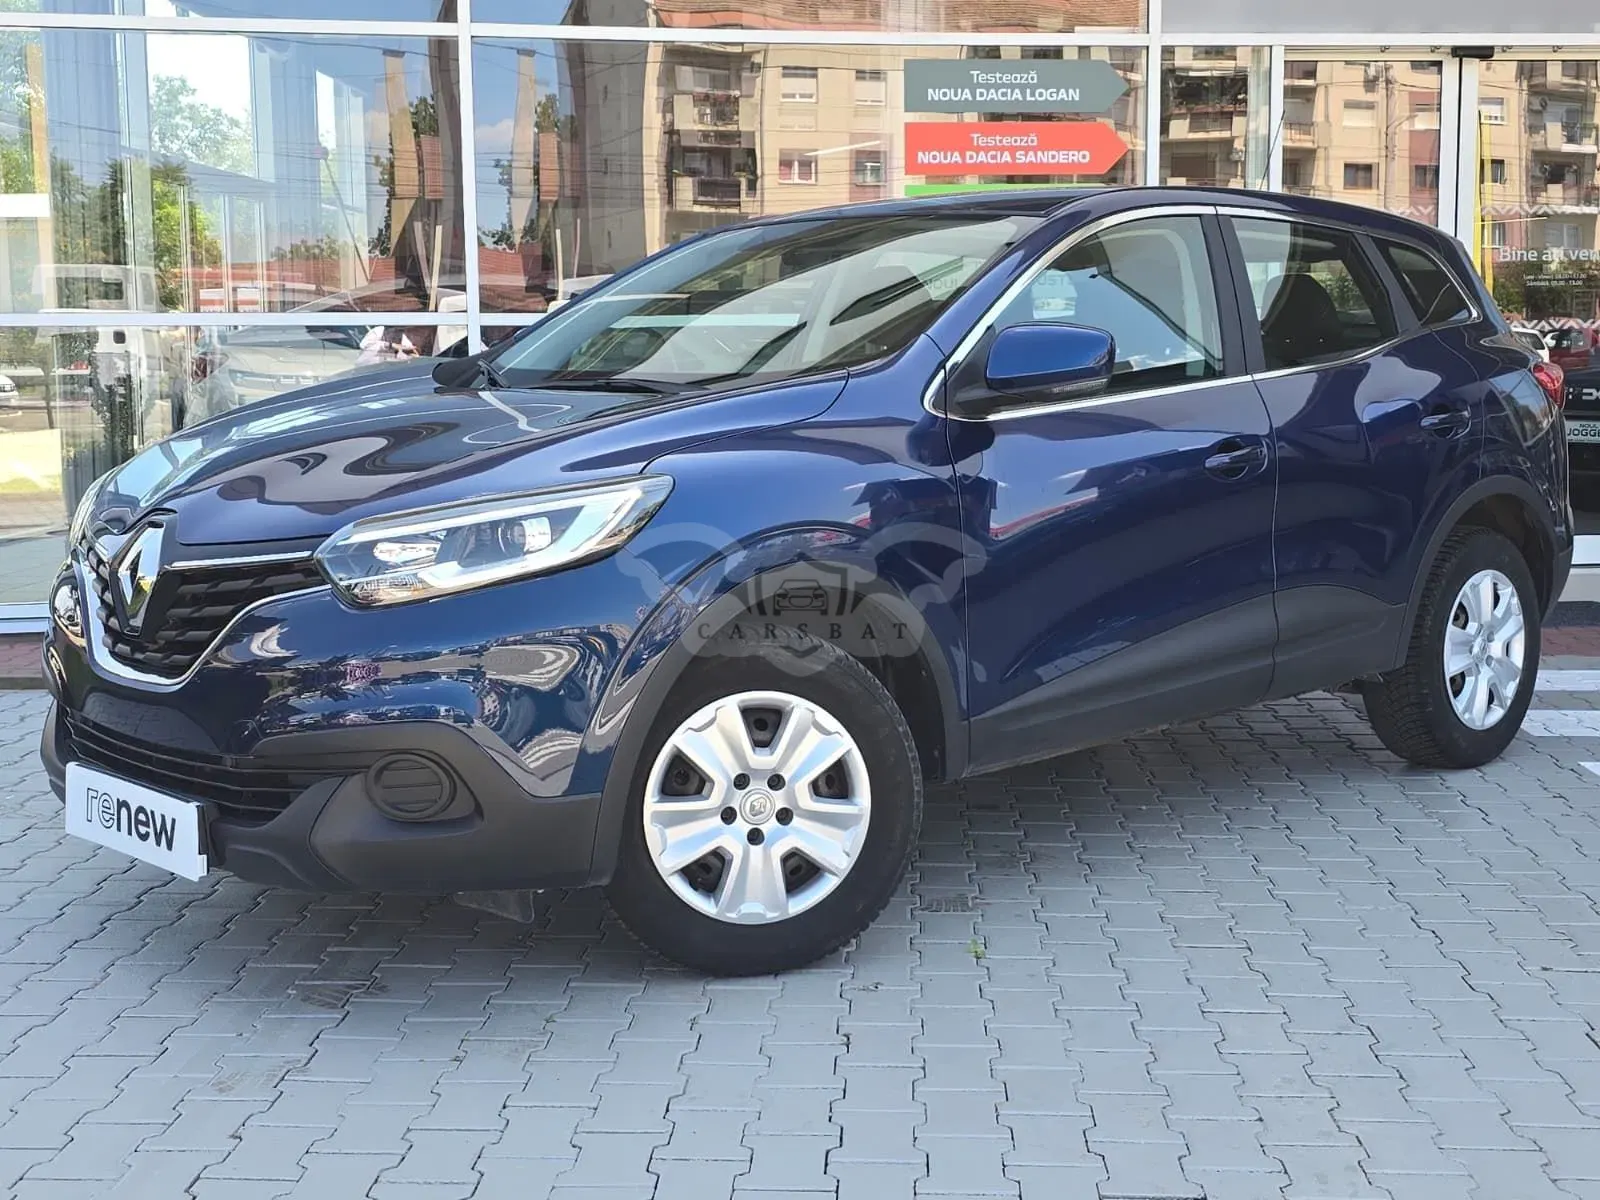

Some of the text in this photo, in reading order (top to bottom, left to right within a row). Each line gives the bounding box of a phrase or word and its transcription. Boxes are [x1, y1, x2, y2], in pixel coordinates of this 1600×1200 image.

[969, 70, 1037, 84] Testează
[927, 88, 1080, 101] NOUA DACIA LOGAN
[970, 133, 1037, 147] Testează
[917, 151, 1090, 164] NOUA DACIA SANDERO
[1499, 247, 1537, 261] Bine
[86, 787, 176, 852] renew
